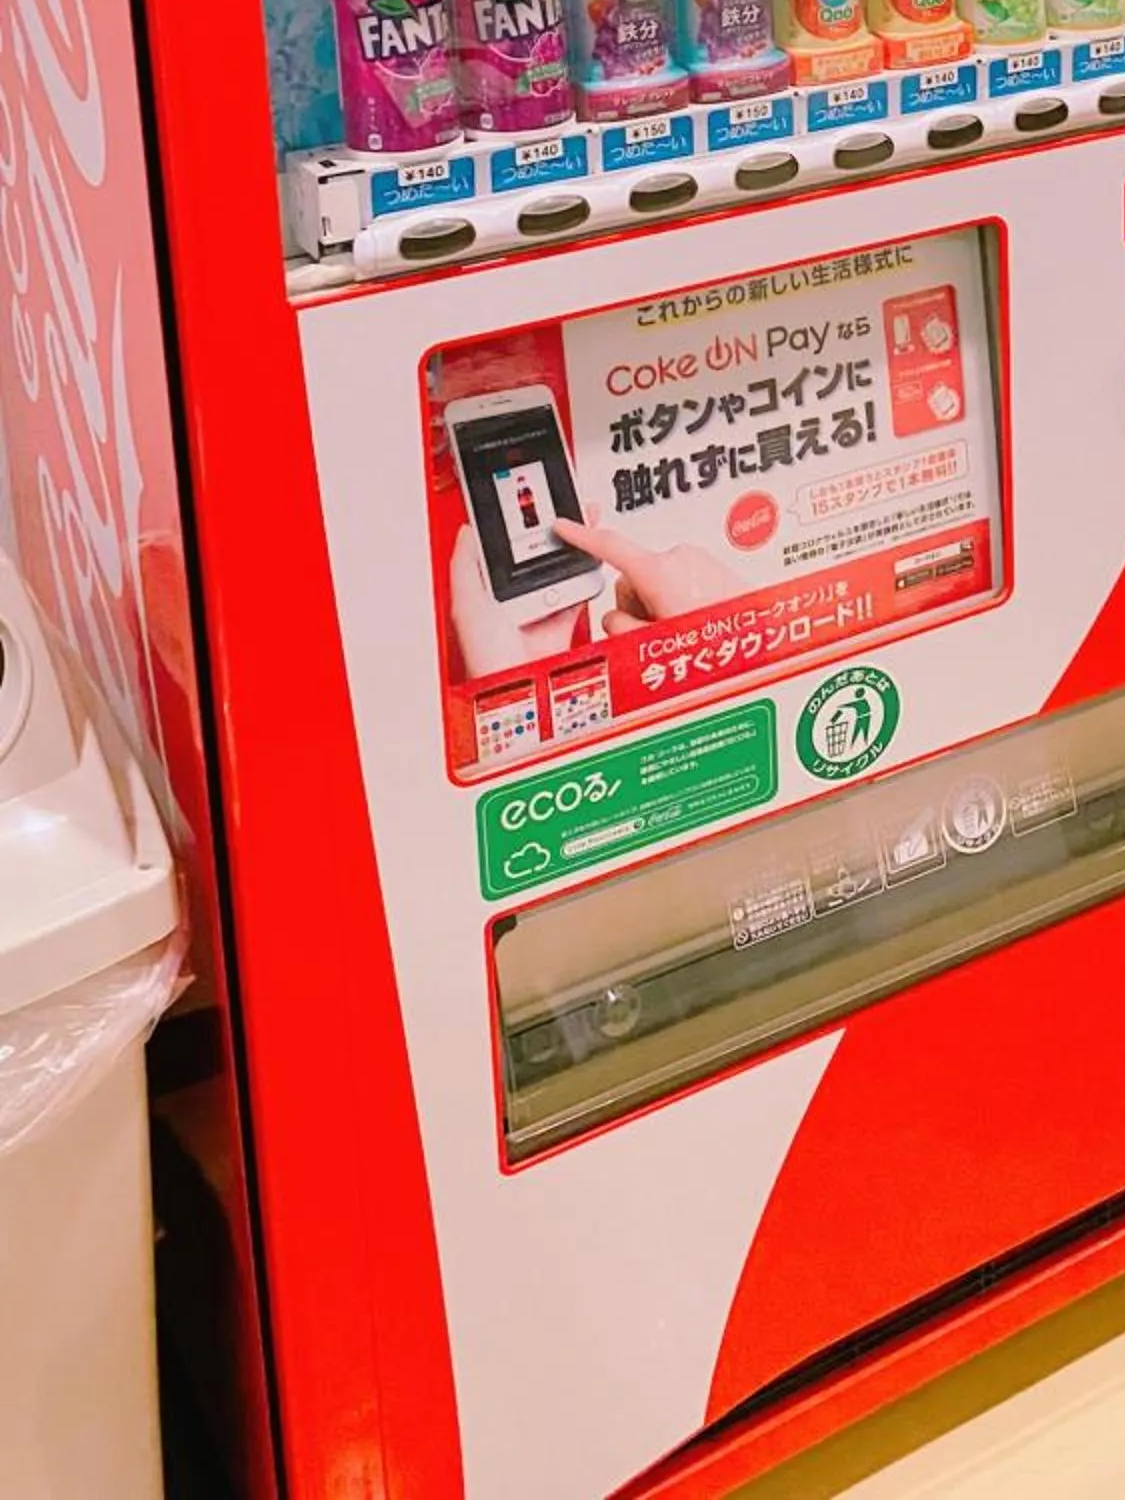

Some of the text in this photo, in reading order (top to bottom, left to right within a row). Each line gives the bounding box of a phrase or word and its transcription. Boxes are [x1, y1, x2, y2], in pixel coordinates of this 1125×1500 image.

[721, 5, 761, 27] 鉄分
[618, 20, 658, 43] 鉄分
[735, 105, 768, 120] ¥150
[631, 123, 665, 138] ¥150
[520, 145, 558, 161] ¥140
[403, 166, 445, 181] ¥140
[636, 245, 913, 327] これからの新しい生活様式に
[606, 316, 871, 397] Coke ON Pay なら
[609, 359, 874, 453] ボタンやコインに
[812, 743, 883, 777] リサイクル
